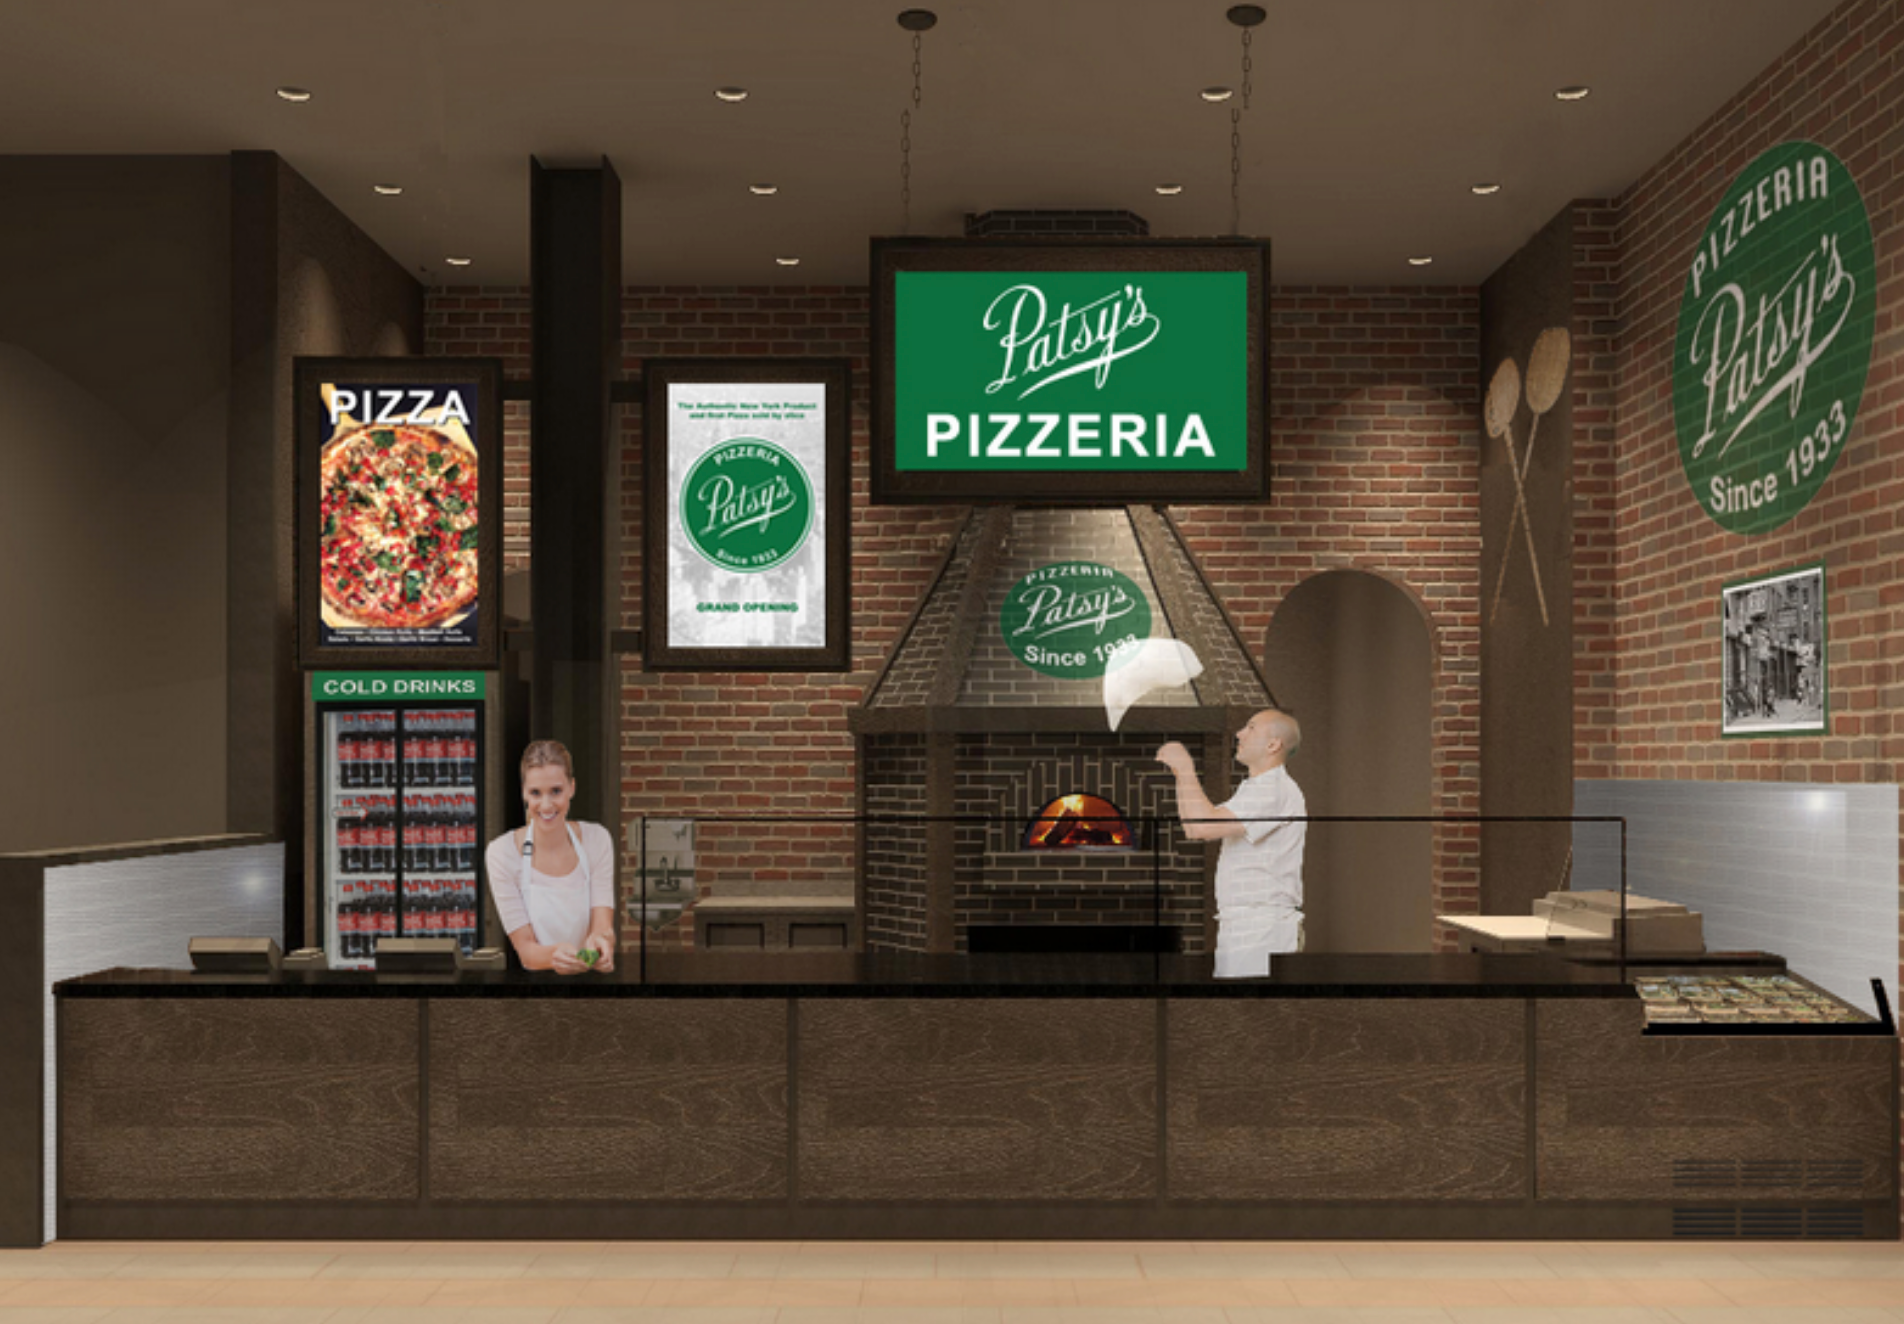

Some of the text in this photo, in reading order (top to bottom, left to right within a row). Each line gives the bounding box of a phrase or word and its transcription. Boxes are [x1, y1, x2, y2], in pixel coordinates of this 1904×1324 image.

[1691, 155, 1829, 299] PIZZERIA
[983, 284, 1161, 400] Patsy's
[1690, 233, 1856, 461] Patsy's
[329, 389, 471, 426] PIZZA
[677, 402, 817, 410] The Authentic New York Product
[926, 413, 1216, 457] PIZZERIA
[713, 446, 781, 467] PIZZERIA
[1710, 399, 1847, 513] Since 1933
[698, 475, 797, 538] Patsy's
[716, 548, 748, 565] Since
[1026, 565, 1114, 585] PIZZERIA
[696, 602, 799, 613] GRAND OPENING
[1012, 584, 1136, 640] Patsy's
[1024, 645, 1087, 667] Since
[323, 679, 477, 695] COLD DRINKS
